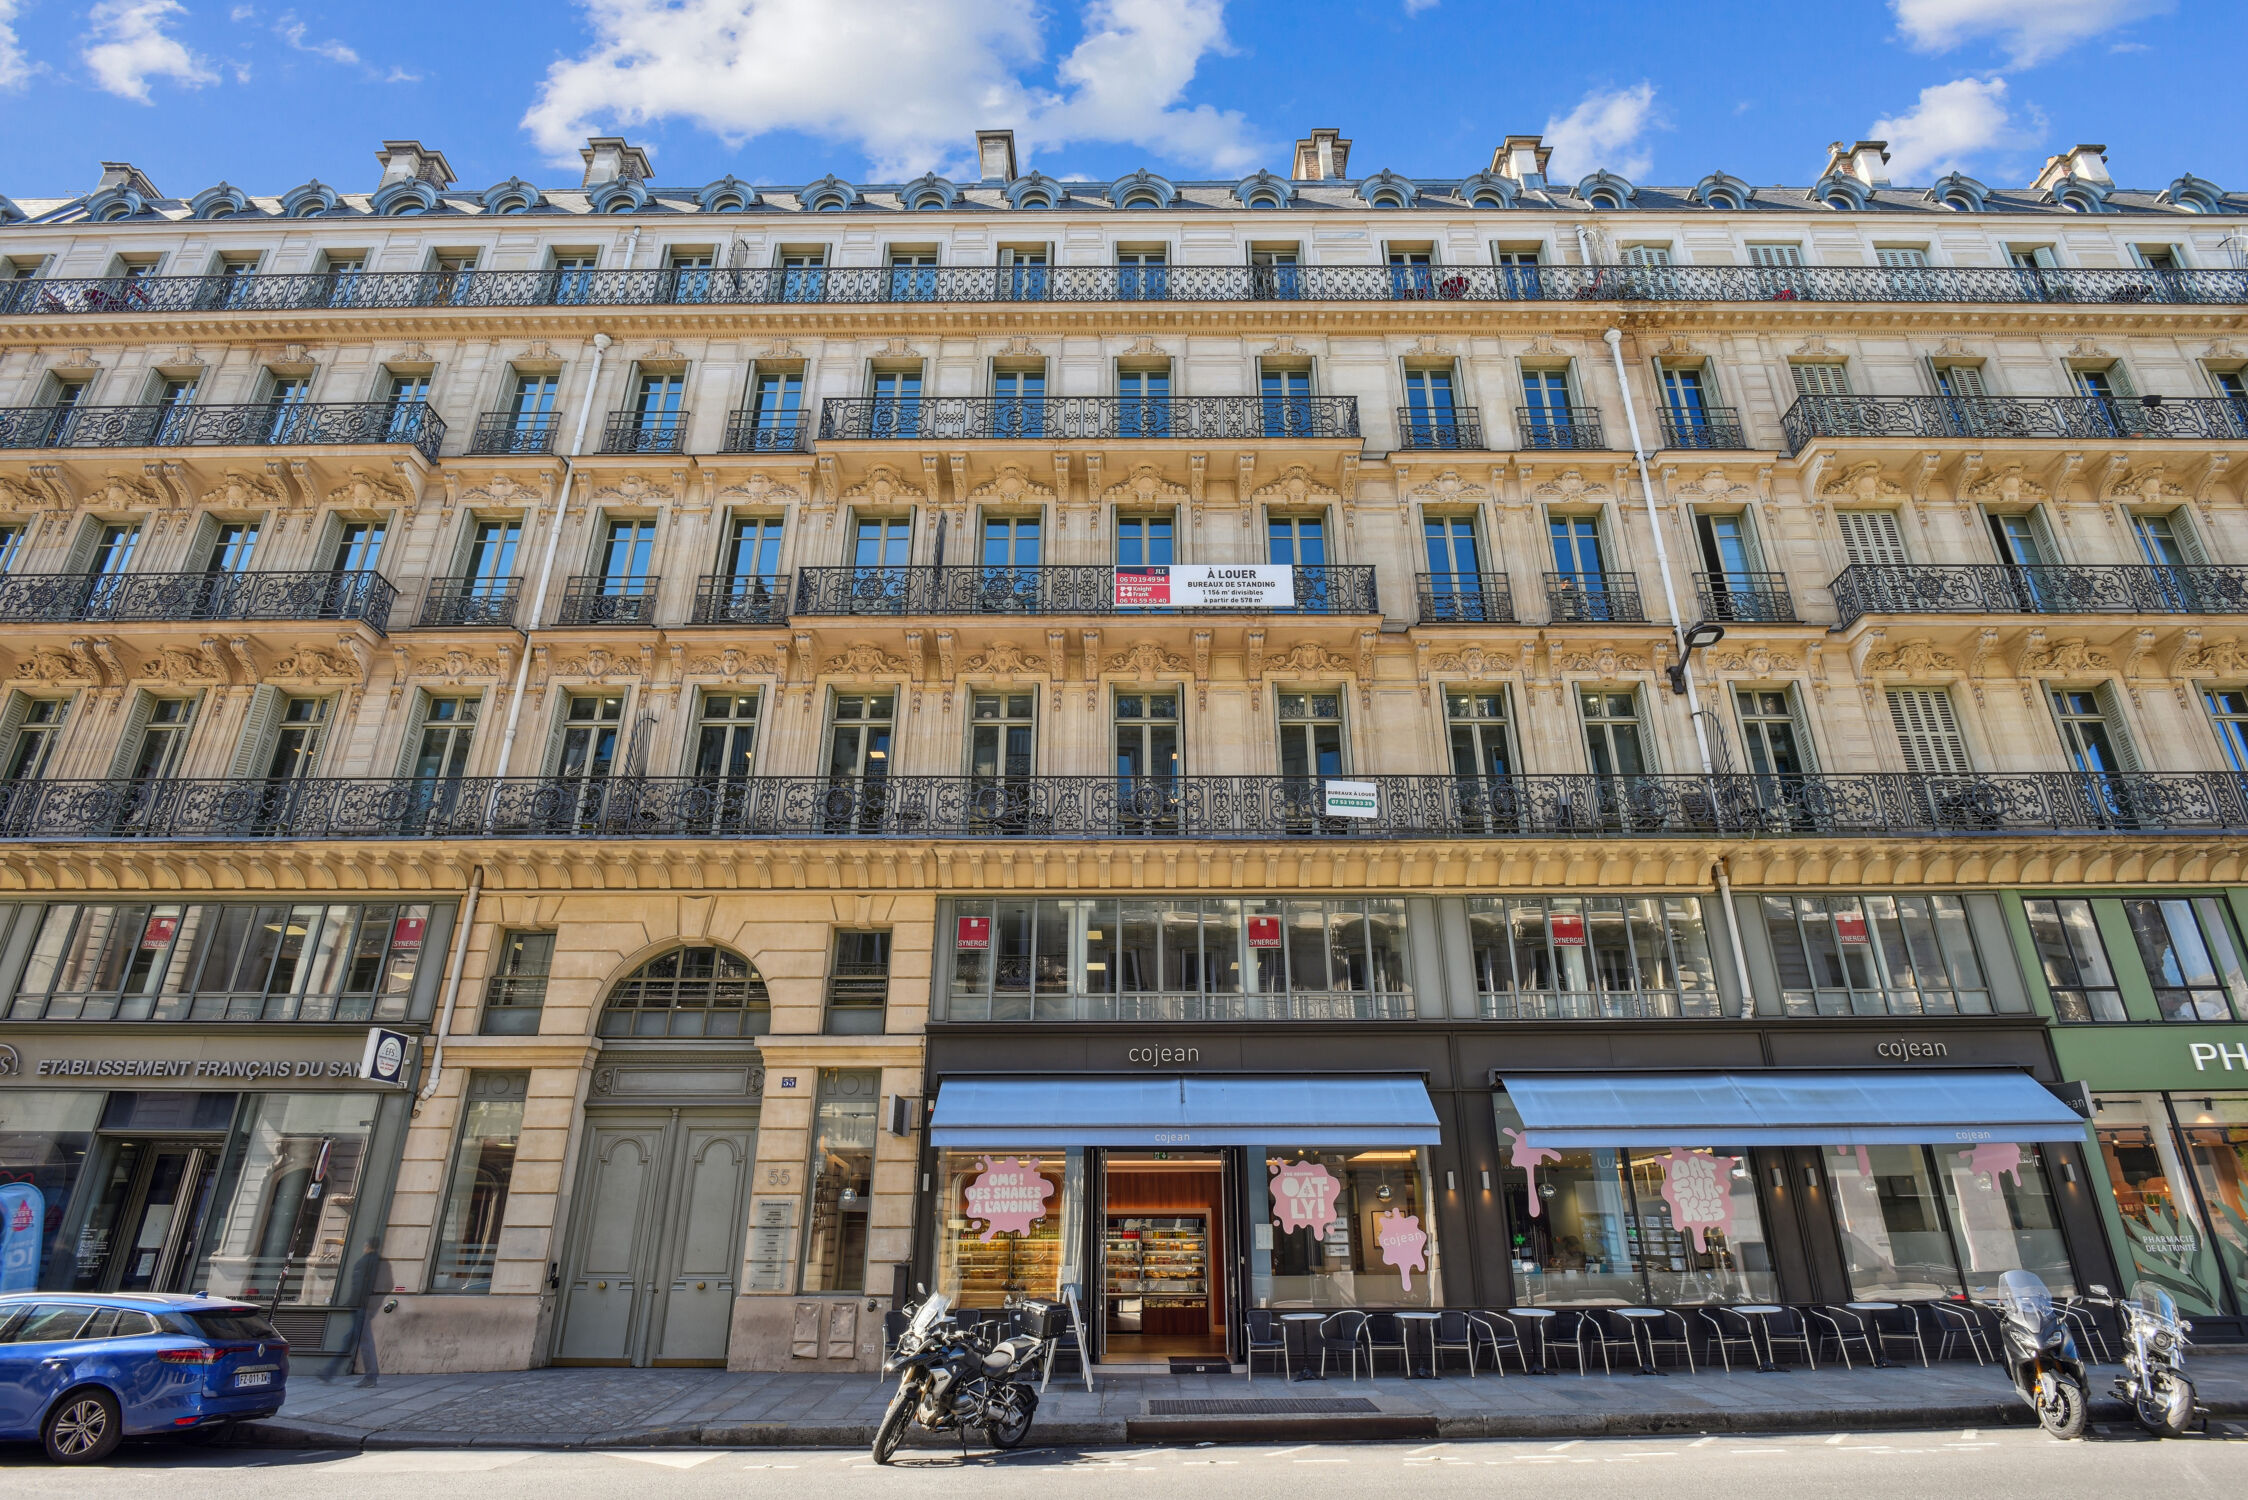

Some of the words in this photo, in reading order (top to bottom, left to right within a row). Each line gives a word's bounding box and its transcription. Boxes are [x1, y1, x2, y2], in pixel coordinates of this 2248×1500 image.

[1207, 567, 1215, 579] À
[1218, 570, 1257, 579] LOUER
[1128, 1043, 1199, 1067] cojean
[1877, 1038, 1948, 1062] cojean
[36, 1059, 191, 1077] ETABLISSEMENT
[194, 1061, 291, 1080] FRANÇAIS
[295, 1061, 324, 1077] DU
[327, 1061, 368, 1077] SAN
[783, 1079, 795, 1087] 55
[1154, 1131, 1190, 1144] cojean
[1955, 1129, 1991, 1141] cojean
[1671, 1156, 1717, 1182] OAT
[767, 1168, 791, 1185] 55
[989, 1173, 1018, 1186] OMG
[968, 1188, 991, 1201] DES
[993, 1186, 1042, 1199] SHAKES
[984, 1200, 1040, 1213] L'AVOINE
[1680, 1197, 1726, 1223] KES
[1383, 1232, 1422, 1247] cojean
[2142, 1235, 2195, 1243] PHARMACIE
[2145, 1244, 2157, 1252] DE
[2157, 1244, 2167, 1252] LA
